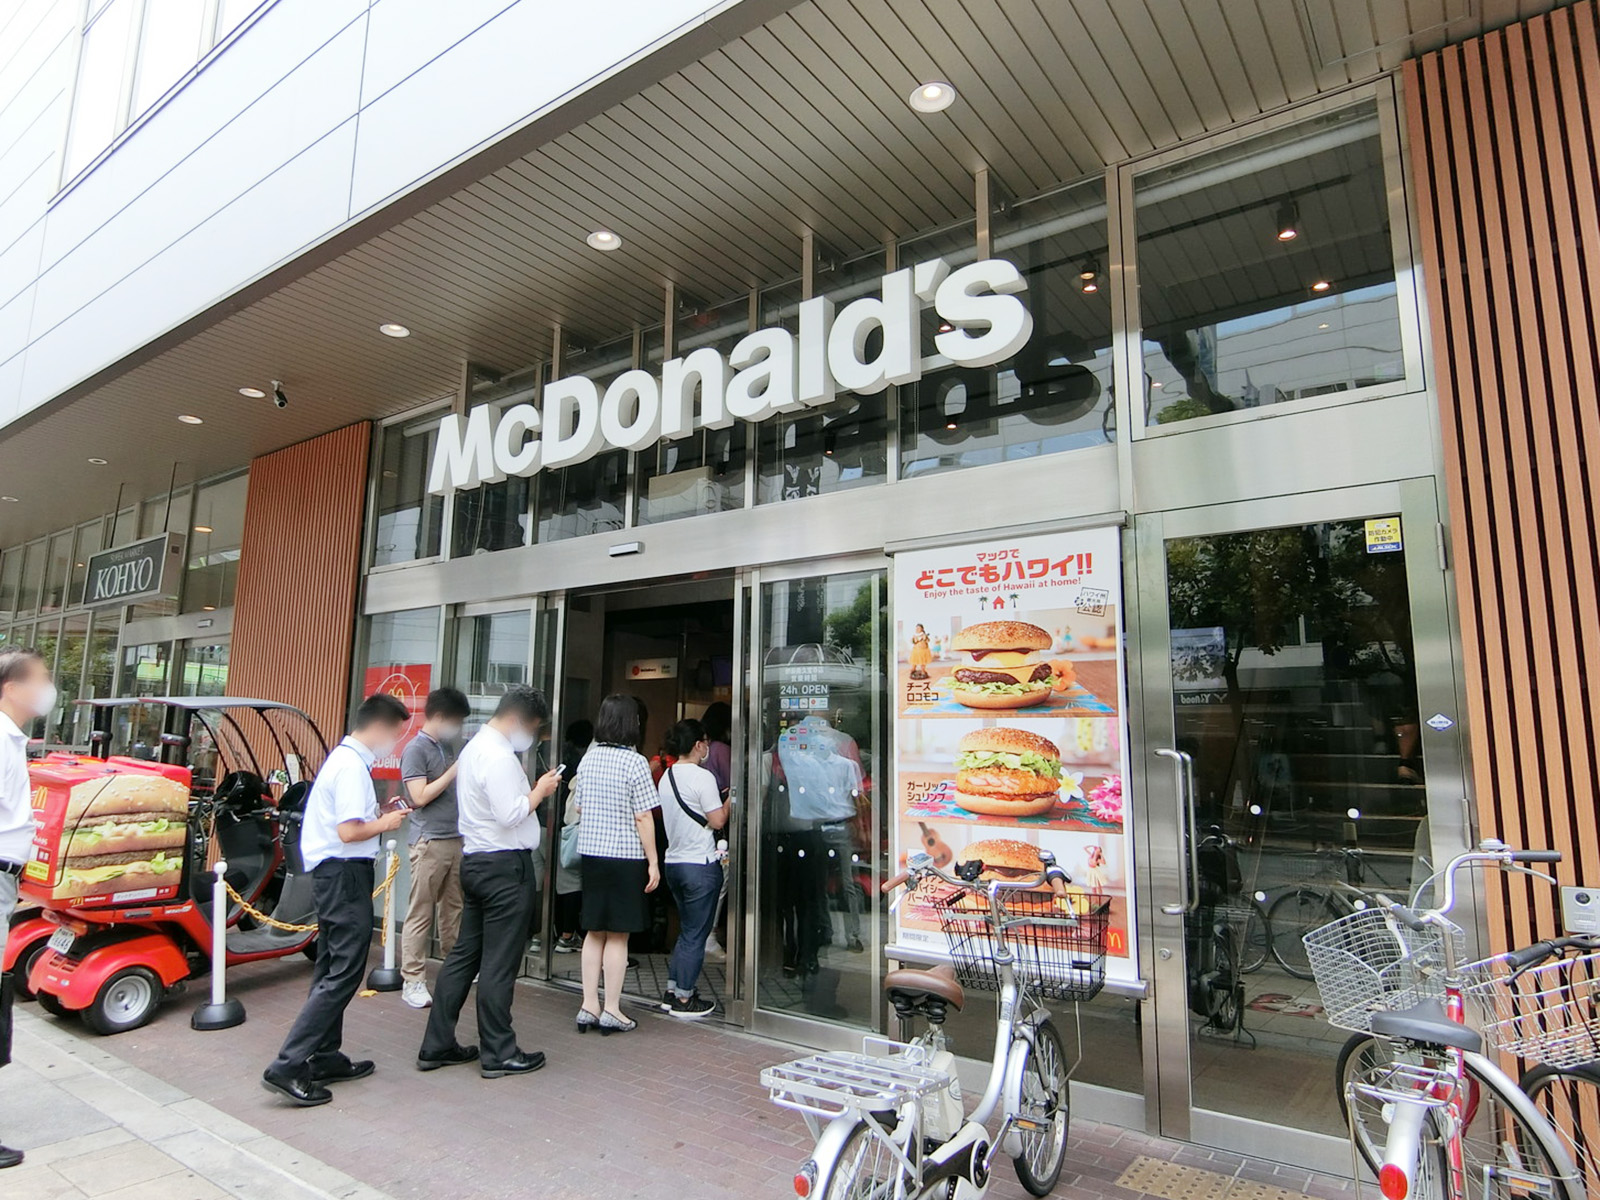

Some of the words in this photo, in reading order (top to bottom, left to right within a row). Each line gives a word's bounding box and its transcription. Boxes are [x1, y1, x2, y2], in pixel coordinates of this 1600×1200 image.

[427, 257, 1034, 495] McDonald's
[976, 549, 1020, 562] マックで
[915, 552, 1093, 590] どこでもハワイ!!
[93, 556, 154, 600] KOHYO
[924, 590, 947, 600] Enjoy
[949, 588, 964, 596] the
[966, 586, 990, 594] taste
[991, 584, 1001, 592] of
[1003, 580, 1035, 590] Hawaii
[1038, 580, 1048, 588] at
[1051, 577, 1082, 587] home!
[780, 685, 798, 695] 24h
[801, 684, 828, 695] OPEN
[906, 682, 931, 692] チーズ
[906, 692, 939, 702] ロコモコ
[907, 781, 948, 792] ガーリック
